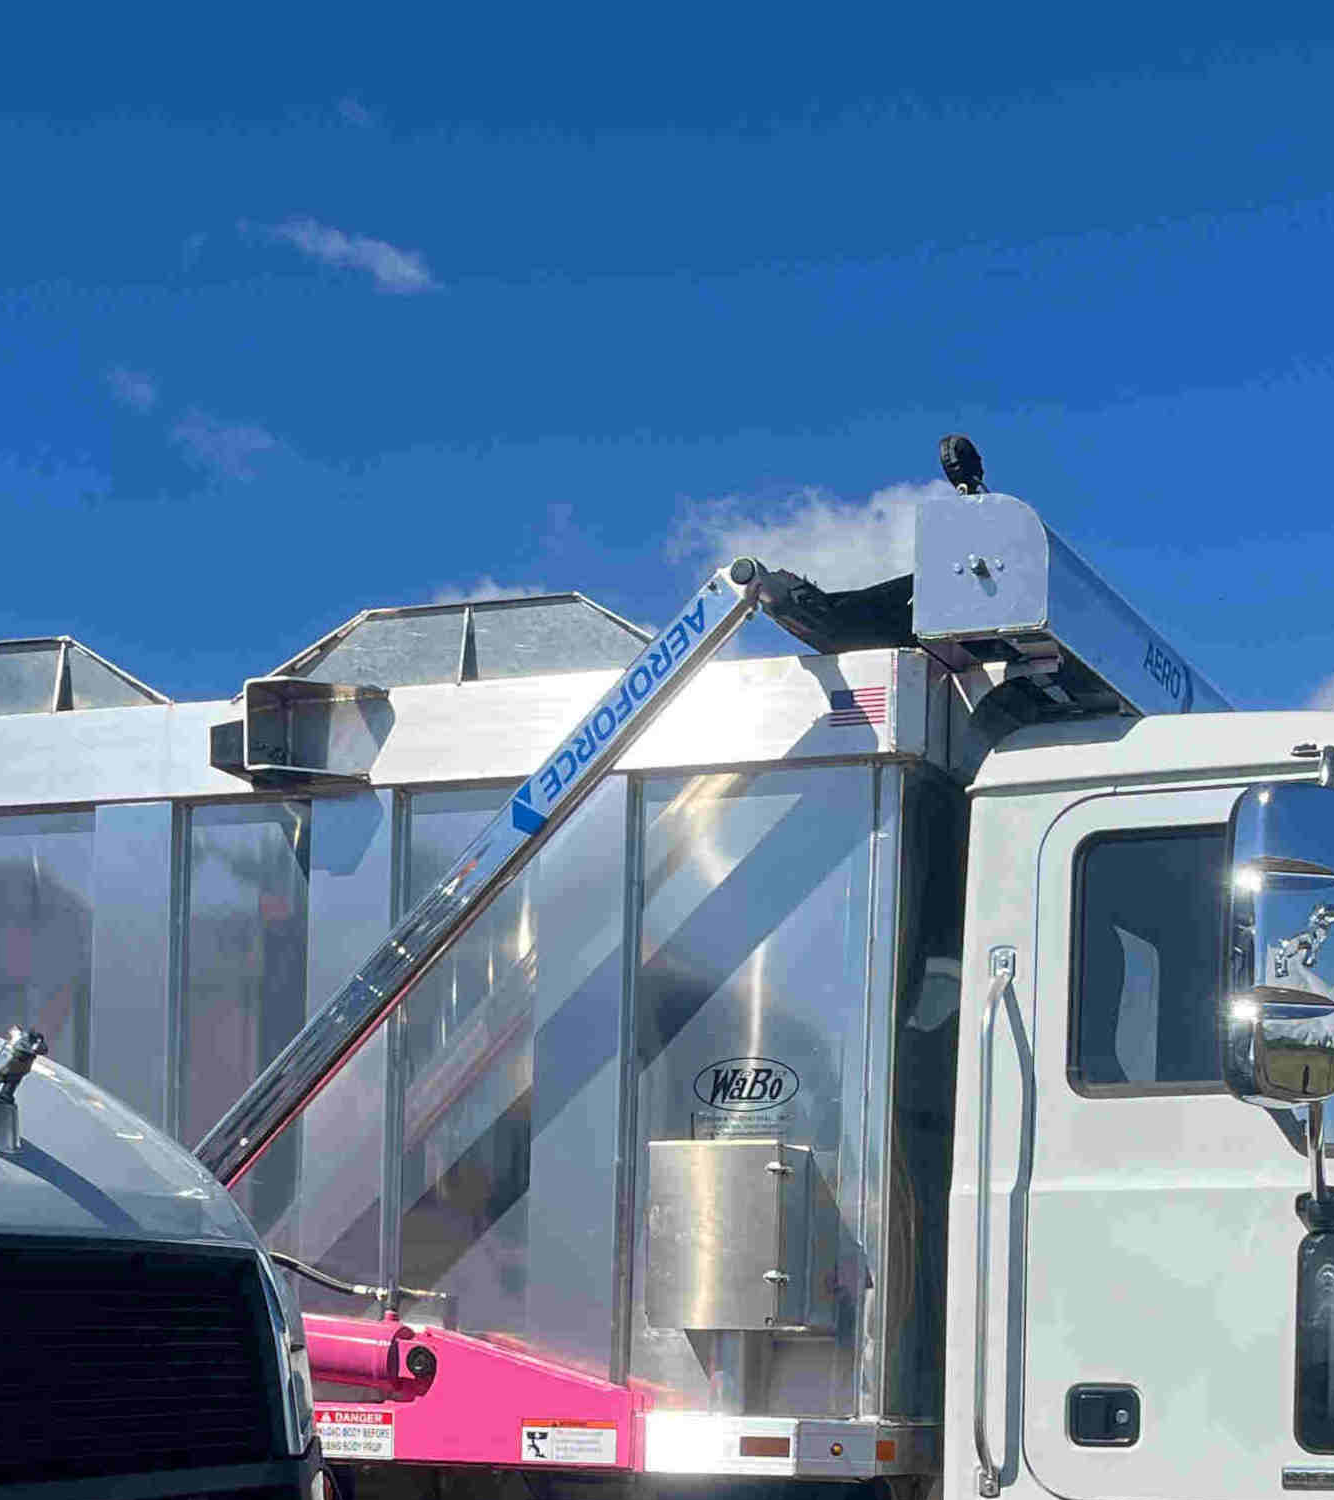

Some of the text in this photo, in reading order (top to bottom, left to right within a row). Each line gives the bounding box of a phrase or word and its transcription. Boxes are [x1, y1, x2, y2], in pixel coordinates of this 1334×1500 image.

[539, 597, 707, 804] AEROFORCE
[710, 1068, 784, 1104] WaBo
[335, 1412, 383, 1424] DANGER
